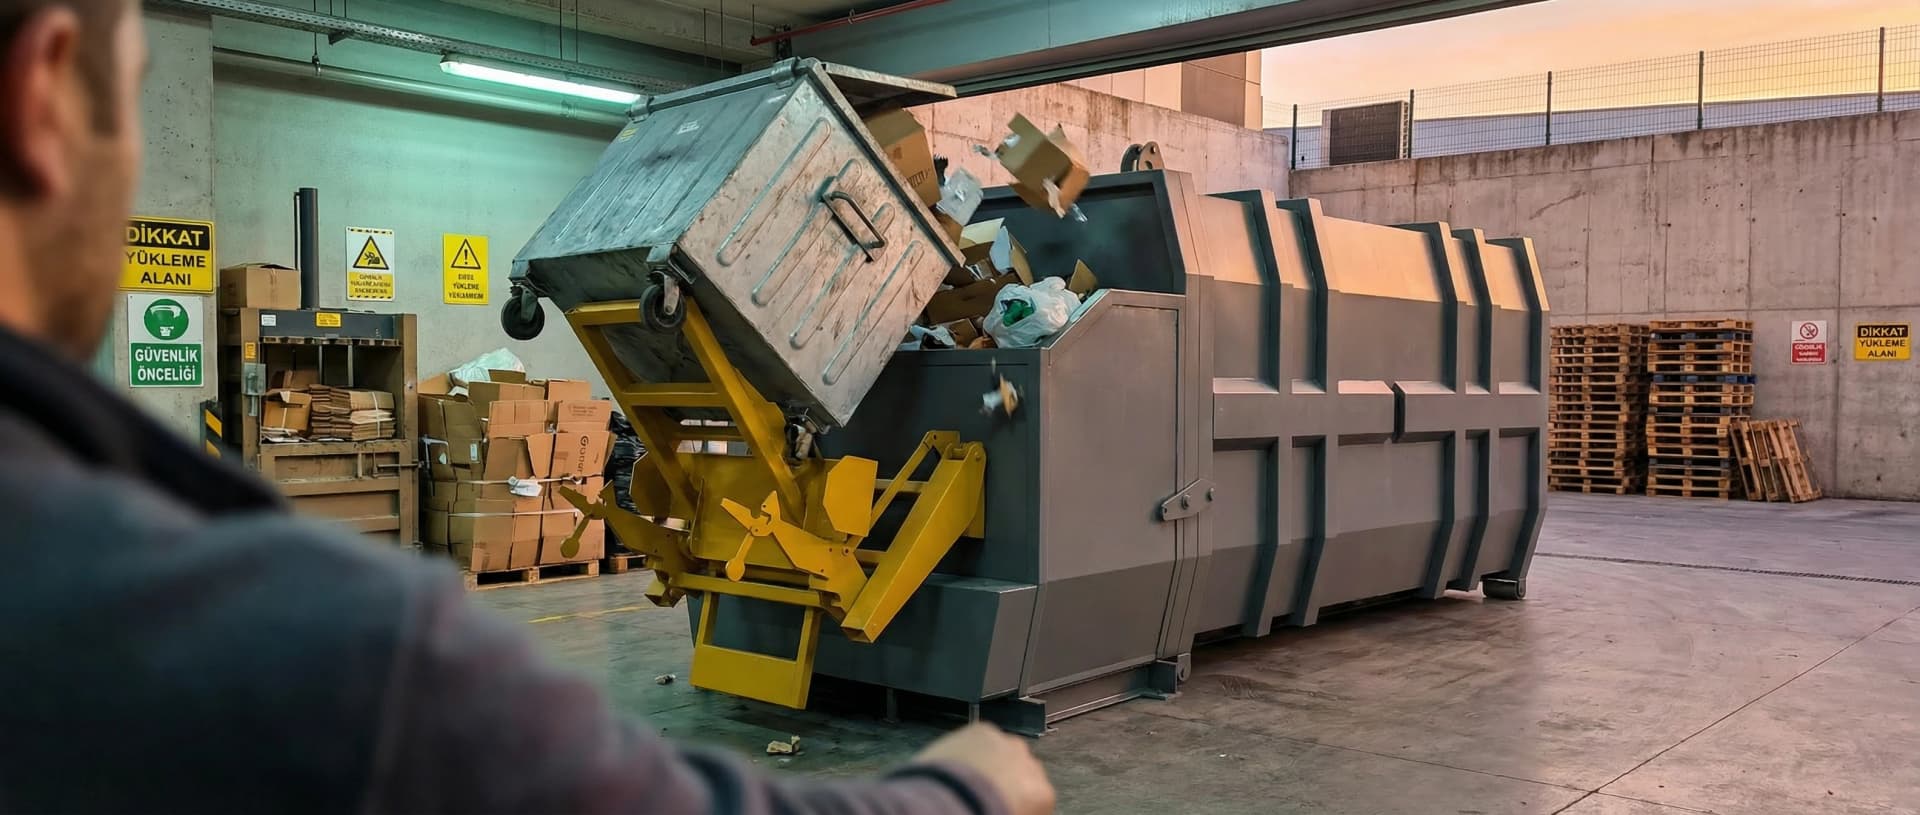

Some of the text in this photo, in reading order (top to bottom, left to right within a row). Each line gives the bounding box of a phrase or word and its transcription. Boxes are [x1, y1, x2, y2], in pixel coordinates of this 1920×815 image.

[126, 223, 204, 247] DİKKAT
[126, 250, 206, 268] YÜKLEME
[140, 271, 191, 286] ALANI
[135, 346, 198, 363] GÜVENLİK
[1867, 349, 1897, 358] ALANI
[137, 365, 196, 382] ÖNCELİĞİ
